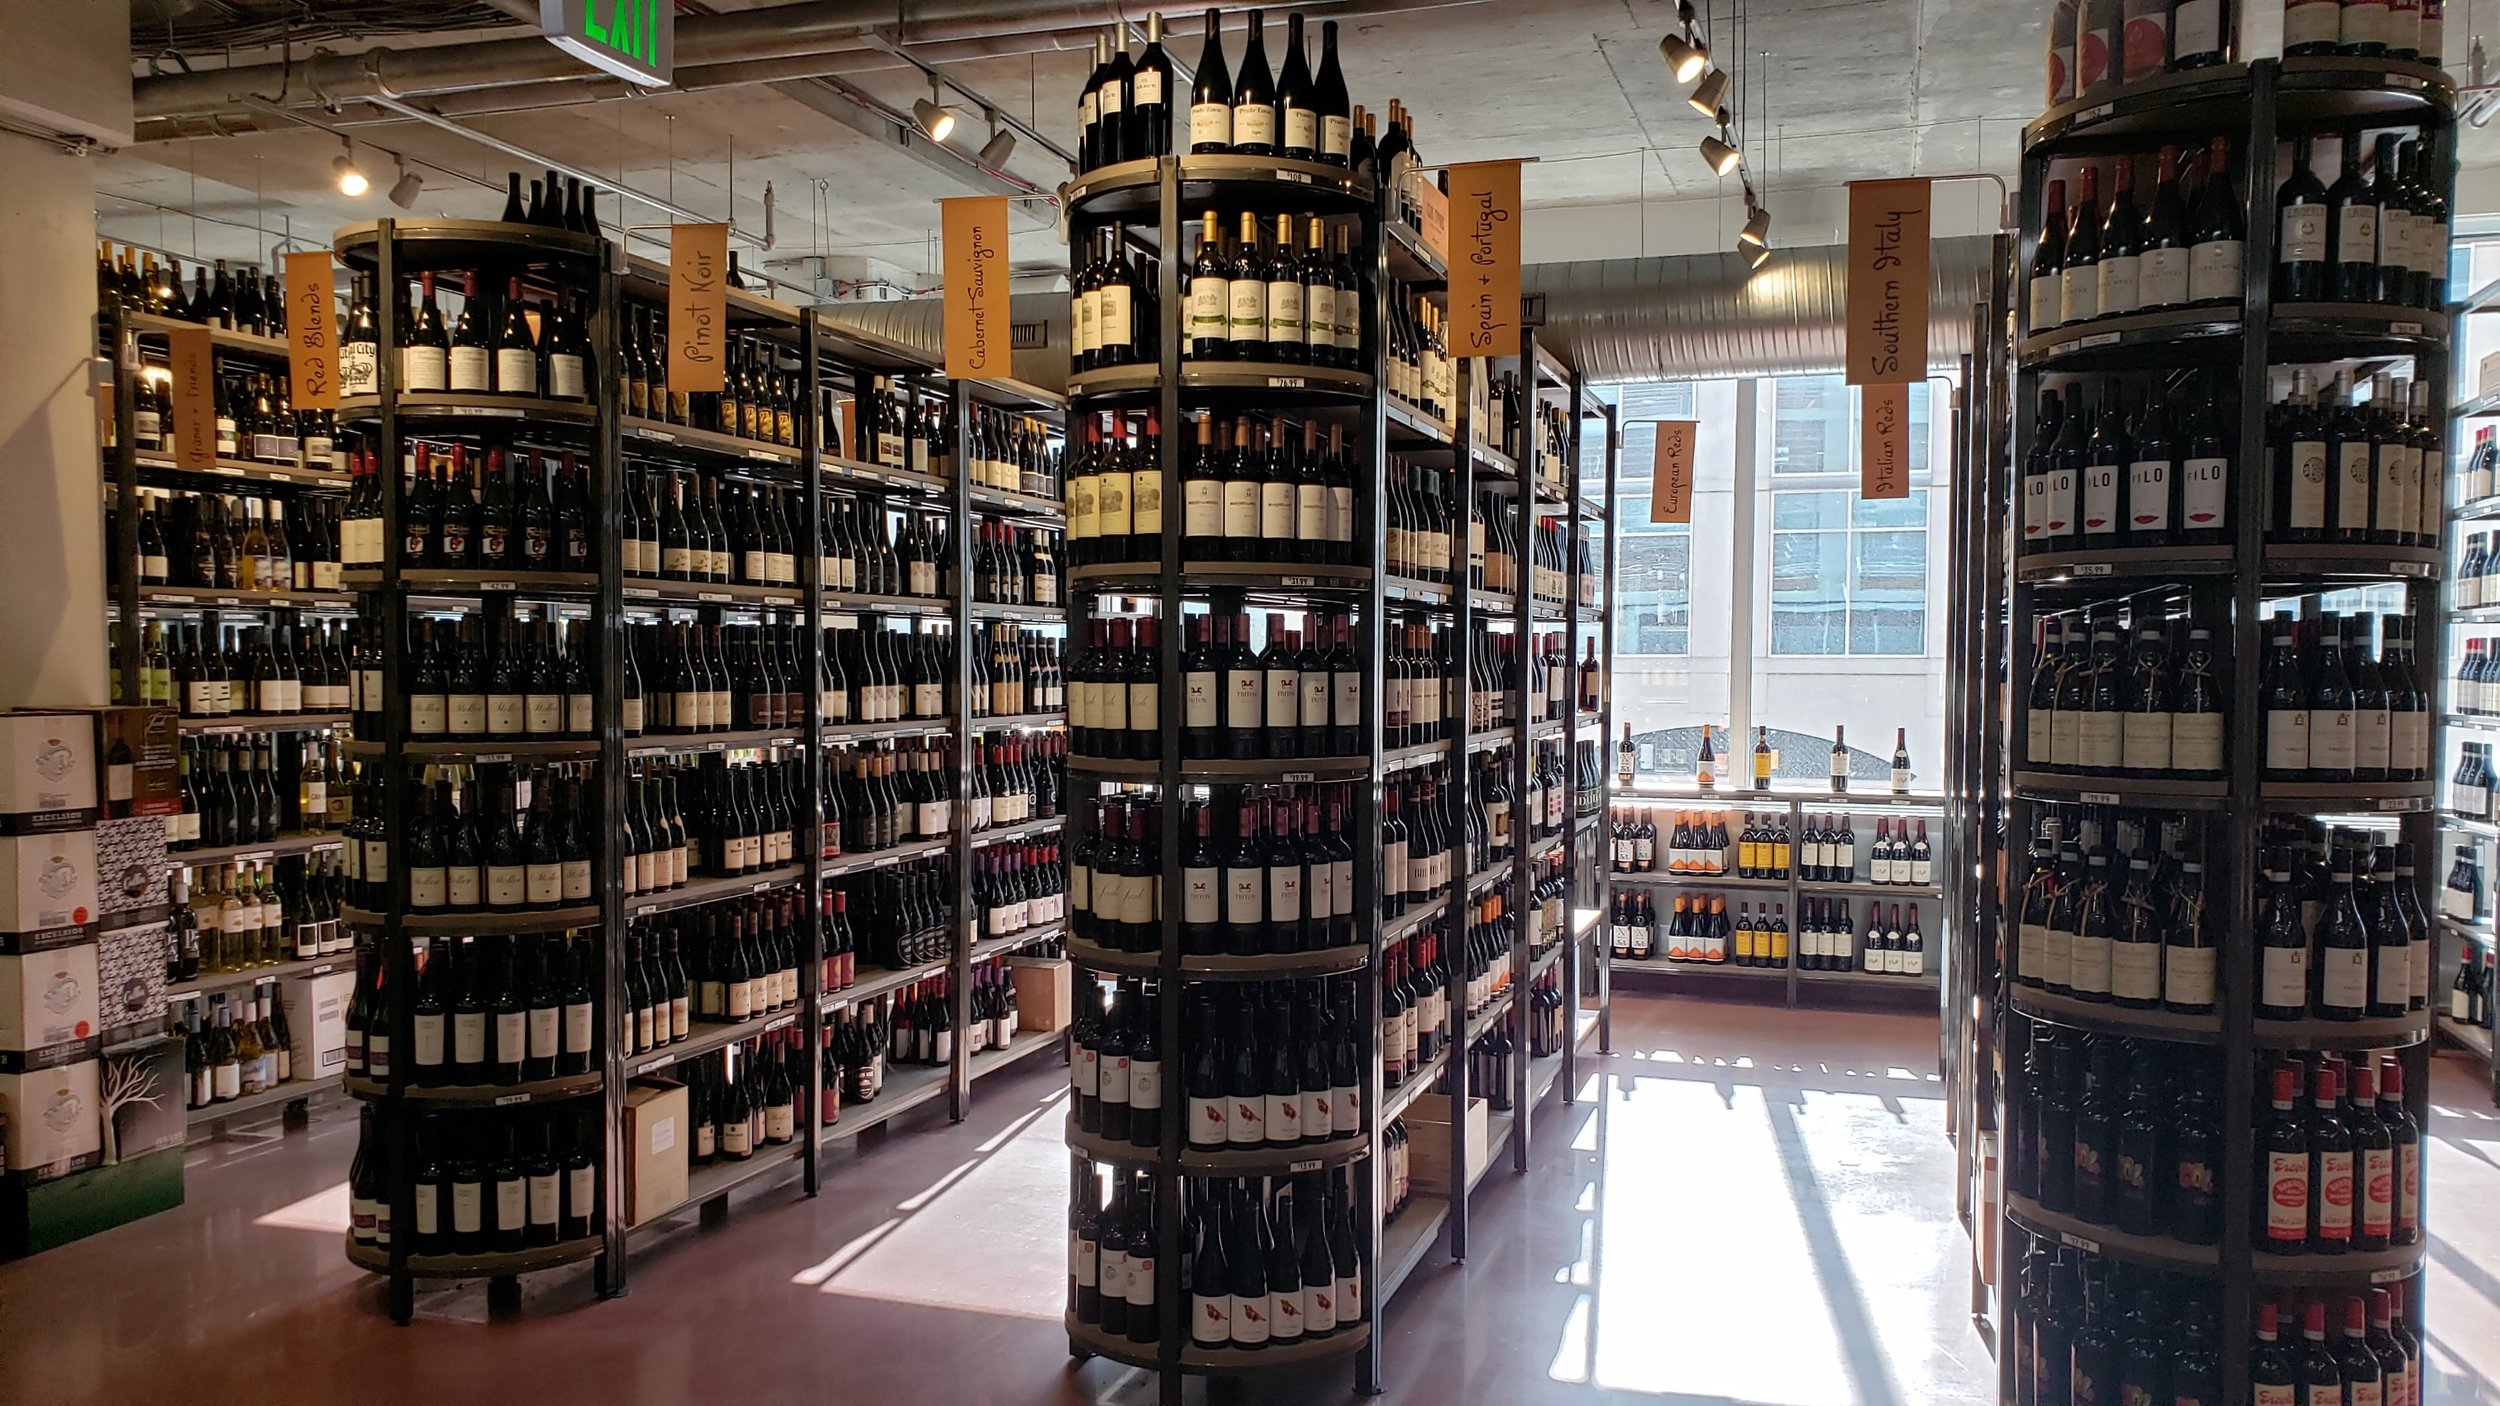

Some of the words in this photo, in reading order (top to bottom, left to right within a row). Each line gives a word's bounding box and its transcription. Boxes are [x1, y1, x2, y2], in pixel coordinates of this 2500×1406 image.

[1470, 191, 1508, 265] Portugal
[1872, 209, 1922, 271] Italy
[681, 250, 715, 292] Noir
[967, 226, 994, 298] Sauvignon
[301, 282, 325, 348] Blends
[684, 303, 714, 362] Pinot
[968, 303, 985, 369] Cabernet
[1470, 293, 1508, 349] Spain
[1871, 280, 1900, 376] Southern
[304, 357, 328, 397] Red
[1667, 430, 1682, 458] Reds
[1876, 399, 1894, 436] Reds
[1663, 463, 1688, 514] European
[1876, 439, 1895, 492] Italian
[2187, 465, 2220, 482] FILO
[32, 811, 82, 822] EXCELSIOR
